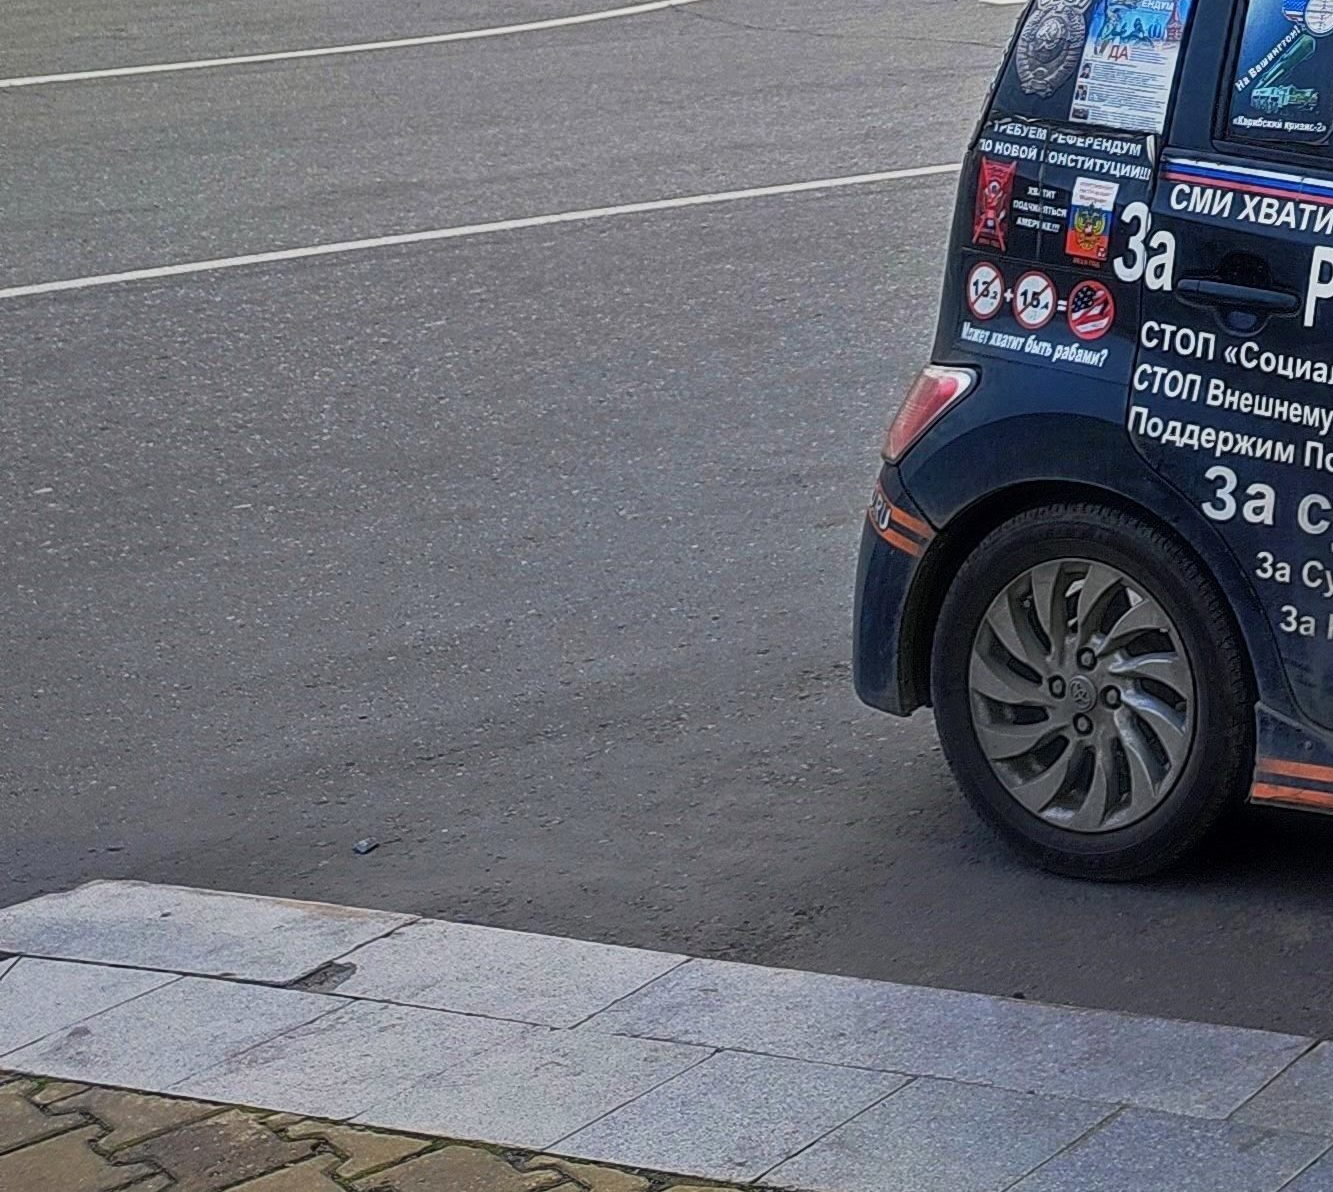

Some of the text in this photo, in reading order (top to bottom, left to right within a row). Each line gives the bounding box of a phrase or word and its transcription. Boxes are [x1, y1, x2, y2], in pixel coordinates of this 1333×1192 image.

[1107, 44, 1129, 61] ДА
[1170, 183, 1234, 219] СМИ
[1112, 201, 1177, 292] За
[1140, 320, 1217, 361] СТОП
[1133, 362, 1202, 403] СТОП
[1126, 405, 1295, 465] Поддержим
[1201, 465, 1277, 526] За
[1255, 551, 1292, 585] За
[1279, 604, 1316, 637] За
